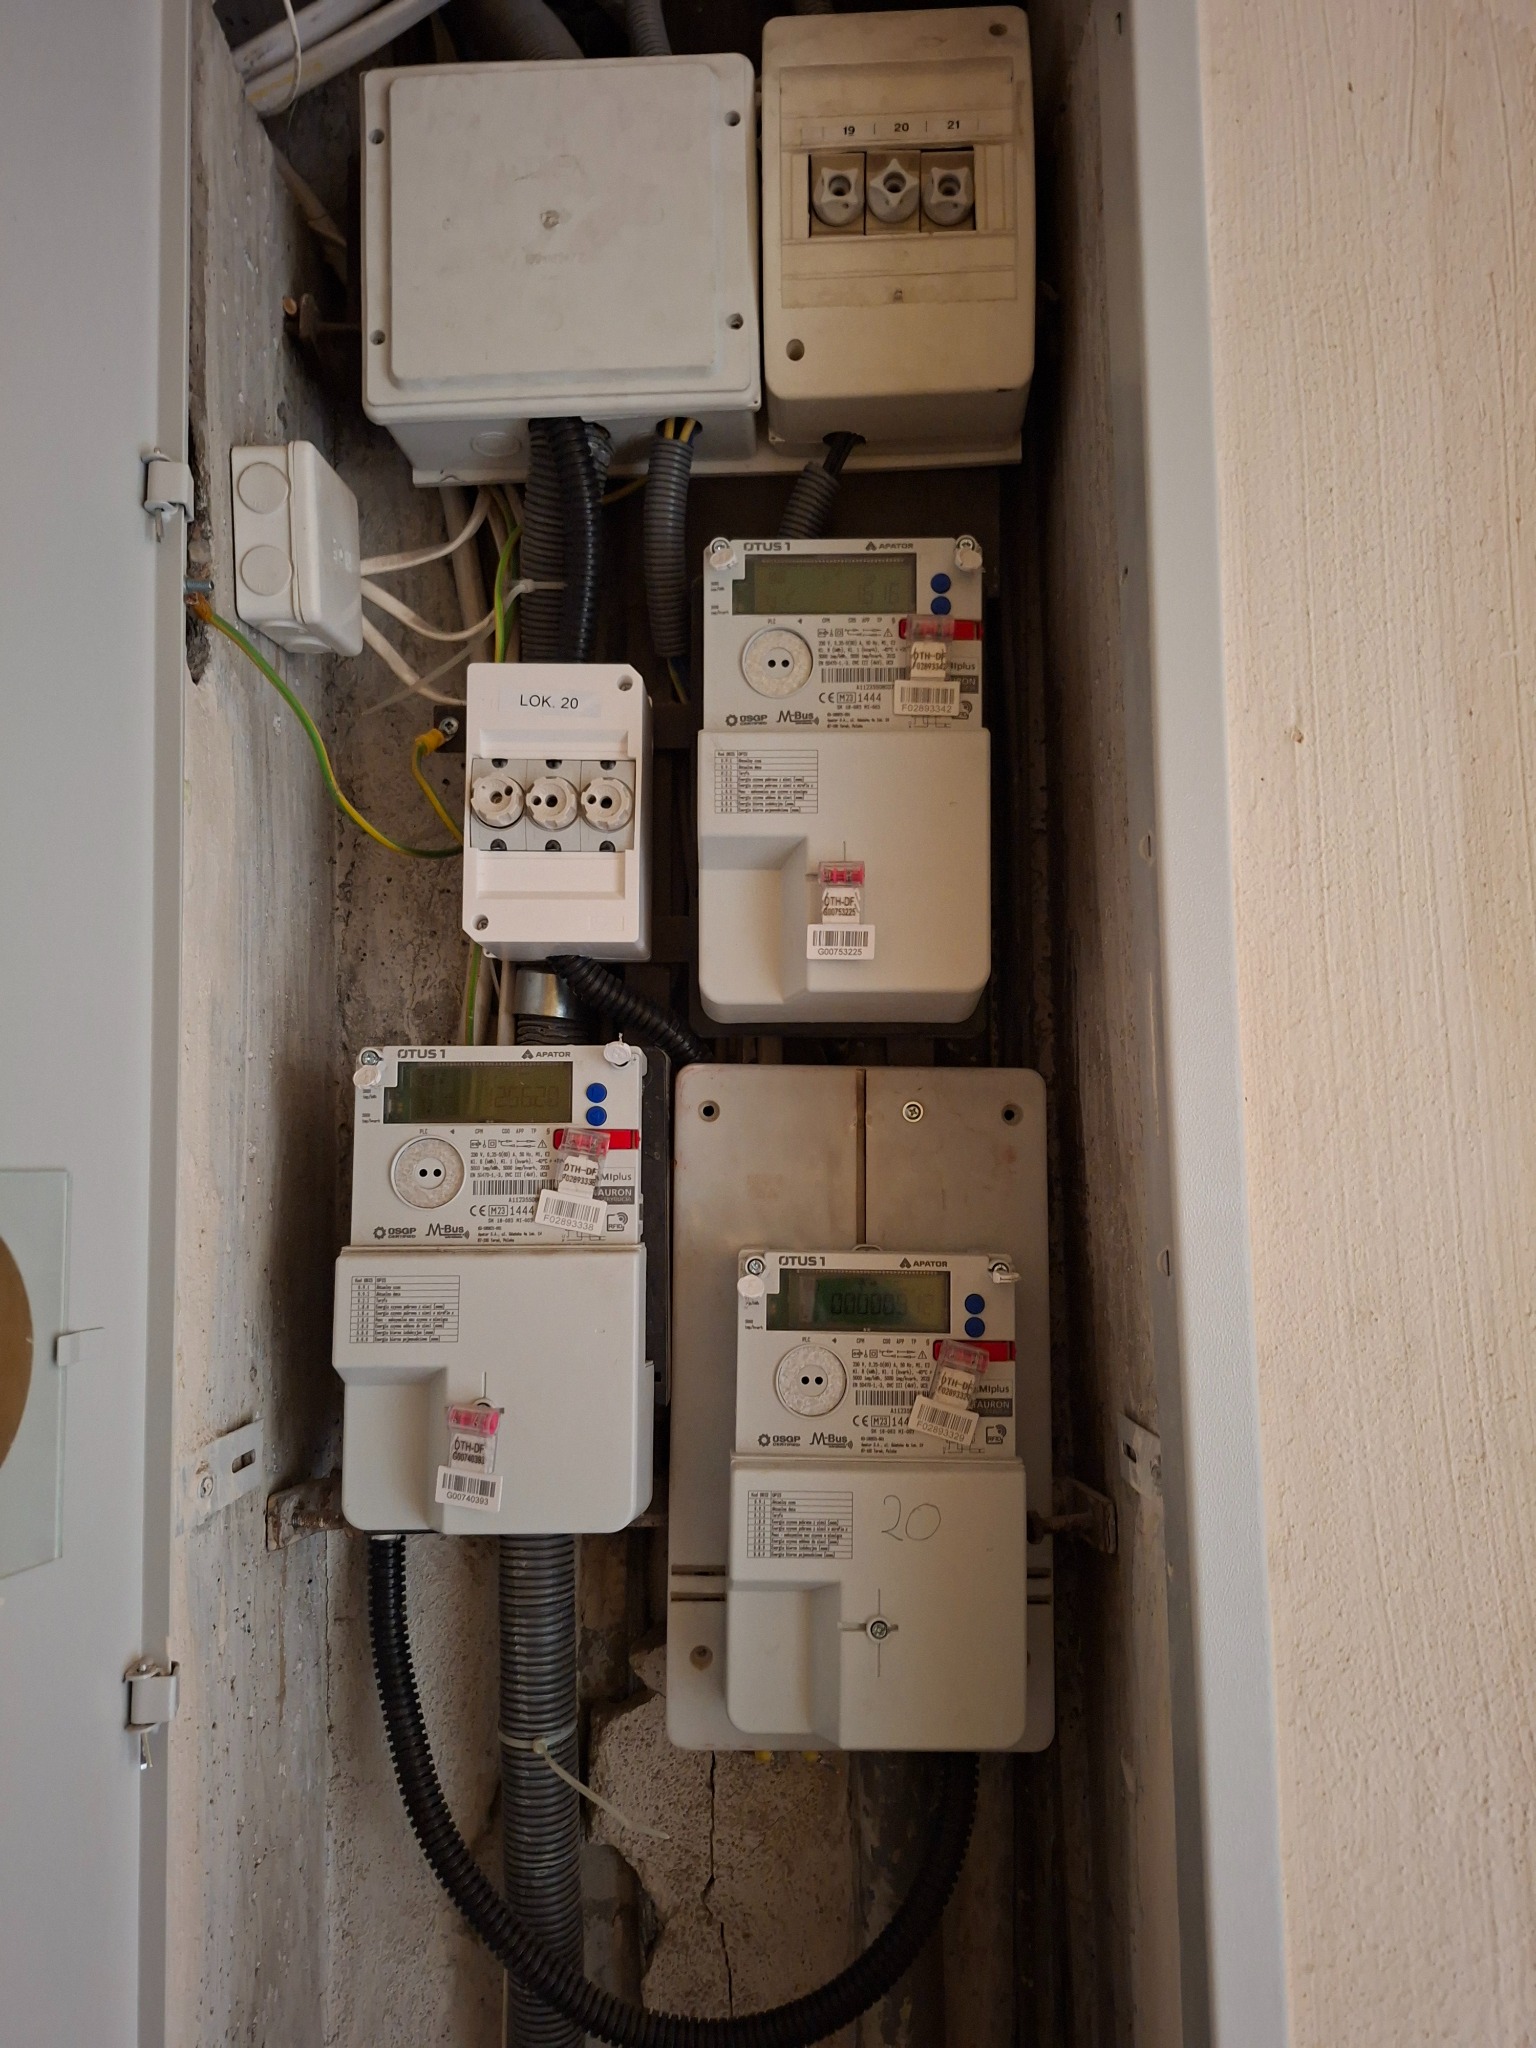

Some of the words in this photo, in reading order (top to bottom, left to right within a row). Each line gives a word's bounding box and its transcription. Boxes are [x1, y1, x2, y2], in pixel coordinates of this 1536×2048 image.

[843, 126, 855, 135] 19
[894, 123, 909, 132] 20
[948, 120, 960, 130] 21
[744, 542, 782, 551] OTUS
[785, 542, 791, 551] 1
[520, 694, 555, 708] LOK.
[561, 697, 579, 709] 20
[859, 693, 882, 701] 1444
[902, 704, 952, 714] F02893342
[776, 710, 814, 722] M-Bus
[818, 948, 862, 956] G00753225
[398, 1049, 437, 1058] OTUS
[441, 1049, 446, 1058] 1
[594, 1188, 632, 1196] AURON
[511, 1206, 534, 1216] 1444
[543, 1214, 594, 1231] F02893338
[425, 1223, 464, 1236] M-Bus
[779, 1256, 817, 1266] OTUS
[820, 1256, 825, 1266] 1
[874, 1417, 888, 1425] M23
[917, 1420, 965, 1442] F02893329
[773, 1435, 801, 1443] OSGP
[810, 1432, 848, 1445] M-Bus
[447, 1491, 489, 1506] G00740393
[881, 1495, 942, 1541] 20
